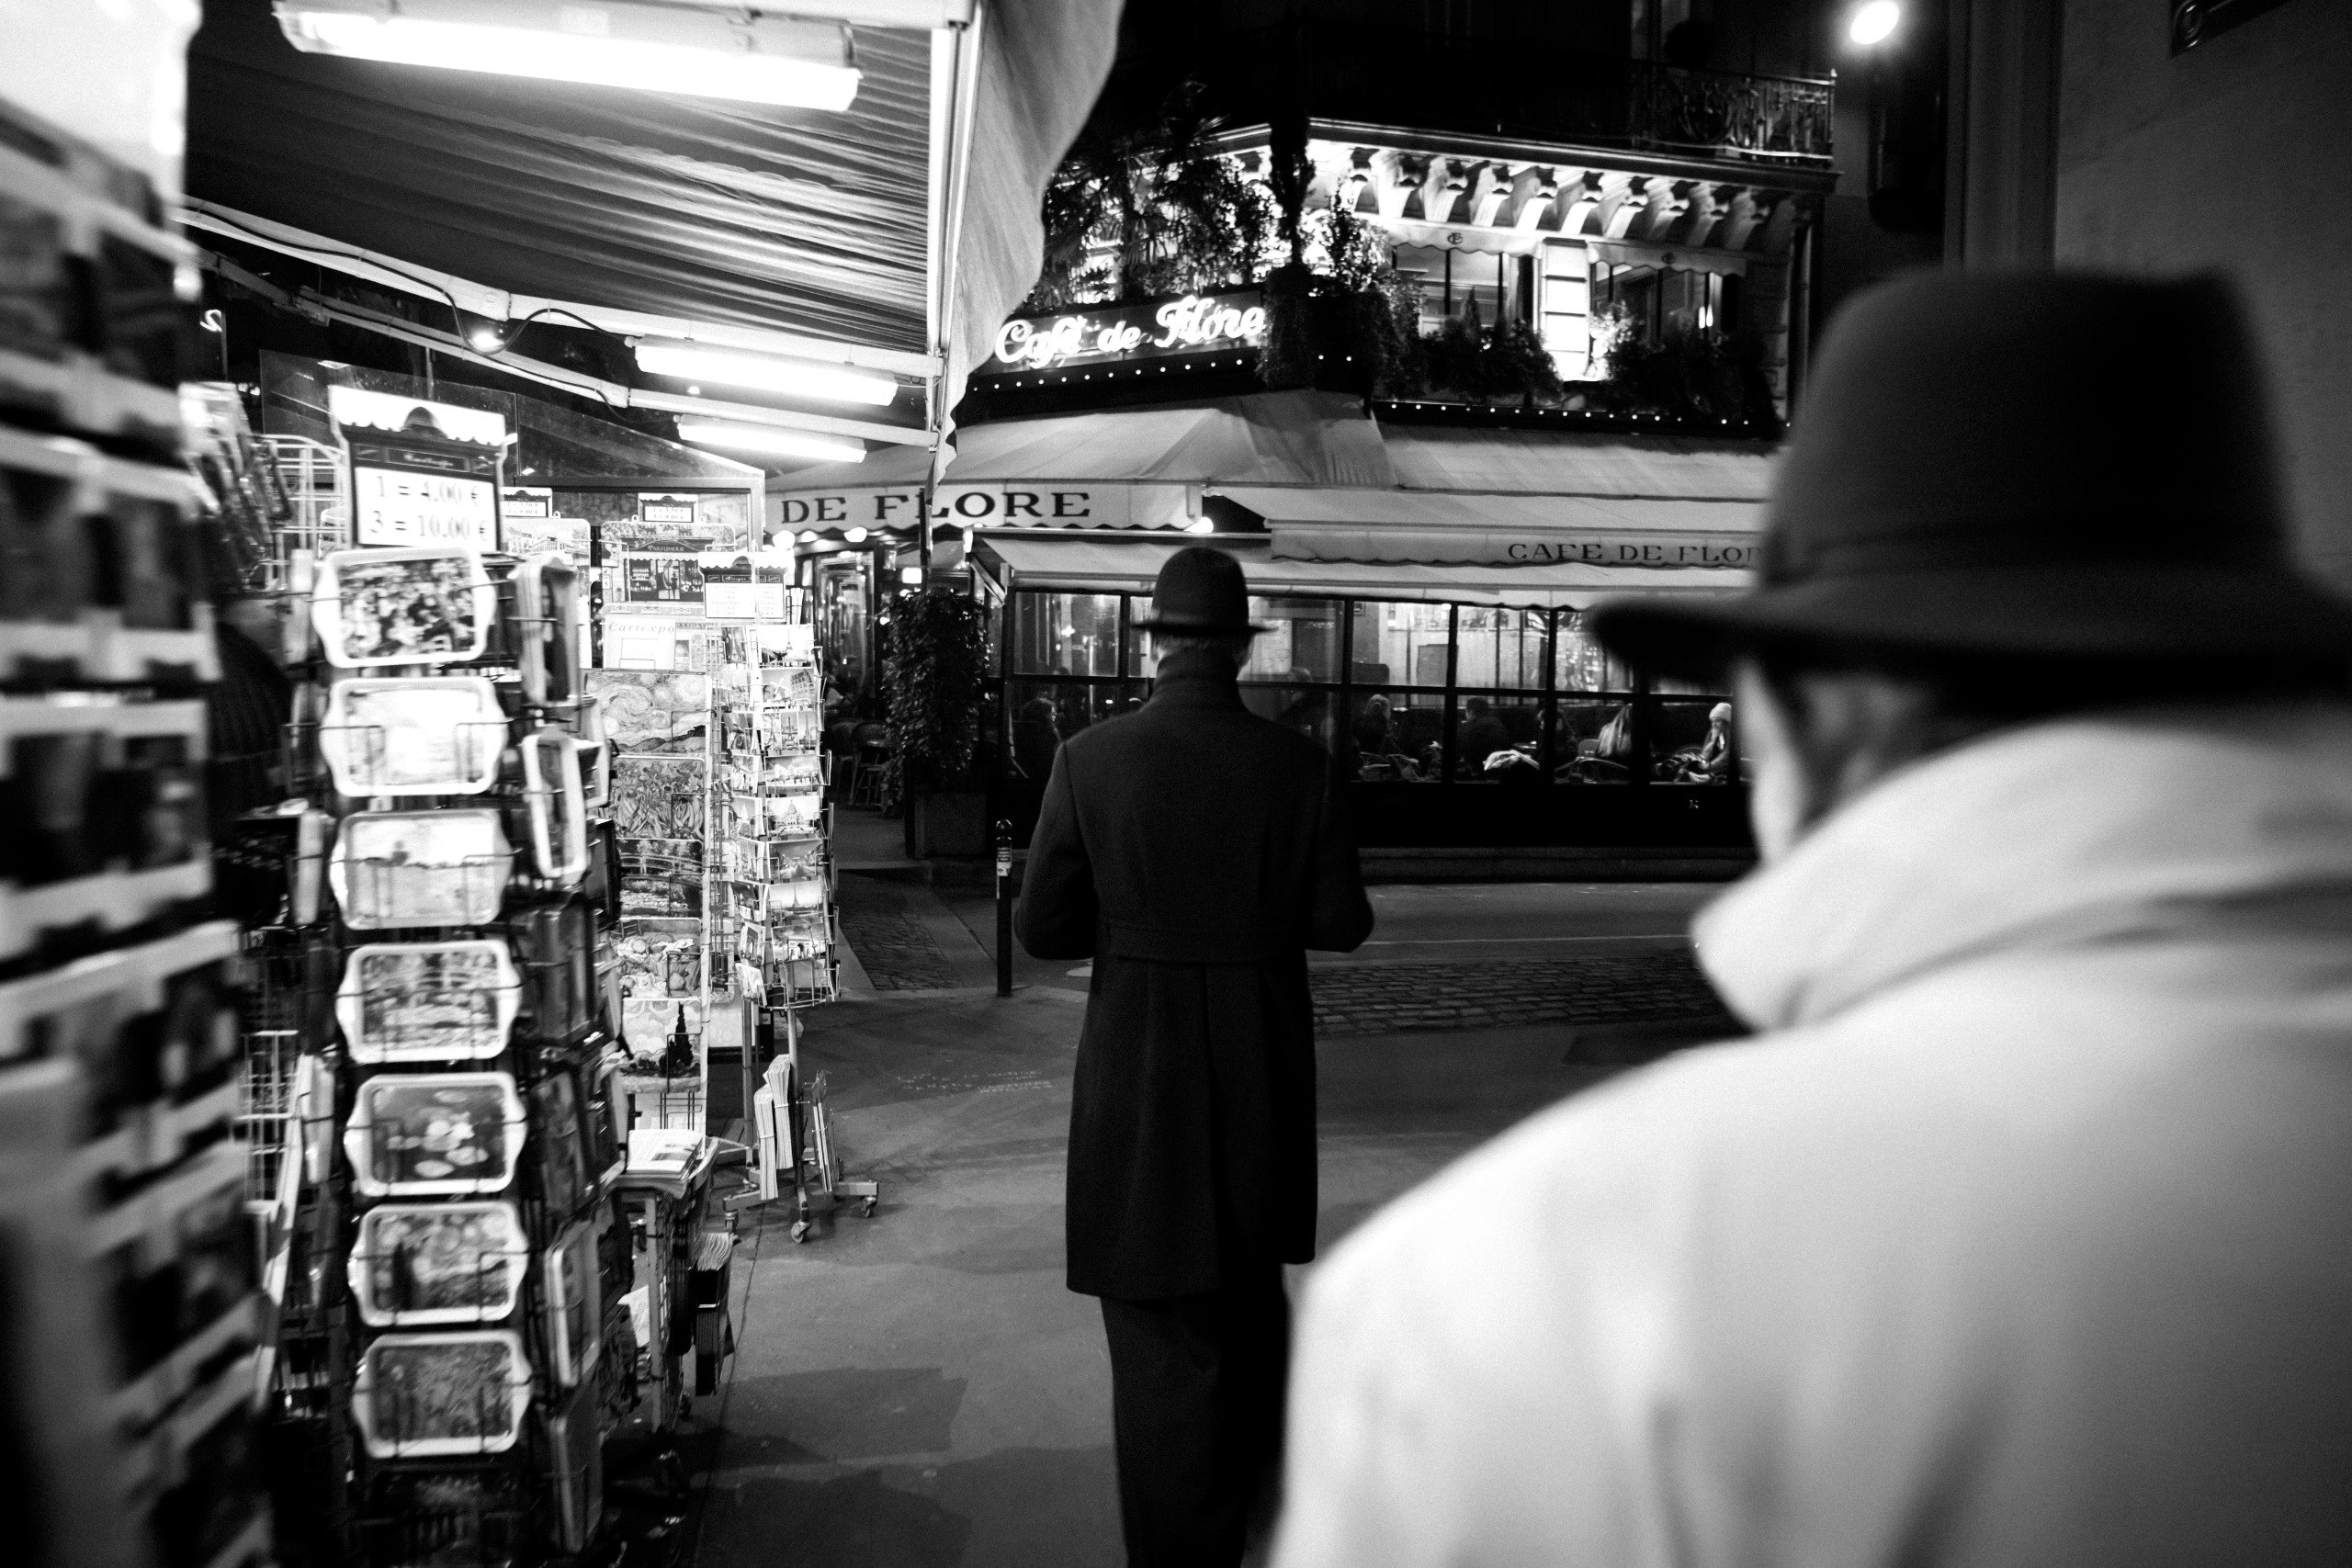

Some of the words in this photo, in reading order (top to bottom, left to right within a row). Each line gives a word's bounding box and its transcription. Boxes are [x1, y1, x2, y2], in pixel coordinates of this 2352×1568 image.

[994, 315, 1088, 369] Café
[1097, 321, 1142, 353] de
[1154, 294, 1265, 349] Flore
[781, 496, 847, 525] DE
[417, 514, 471, 540] 10.00
[1619, 545, 1662, 561] DE
